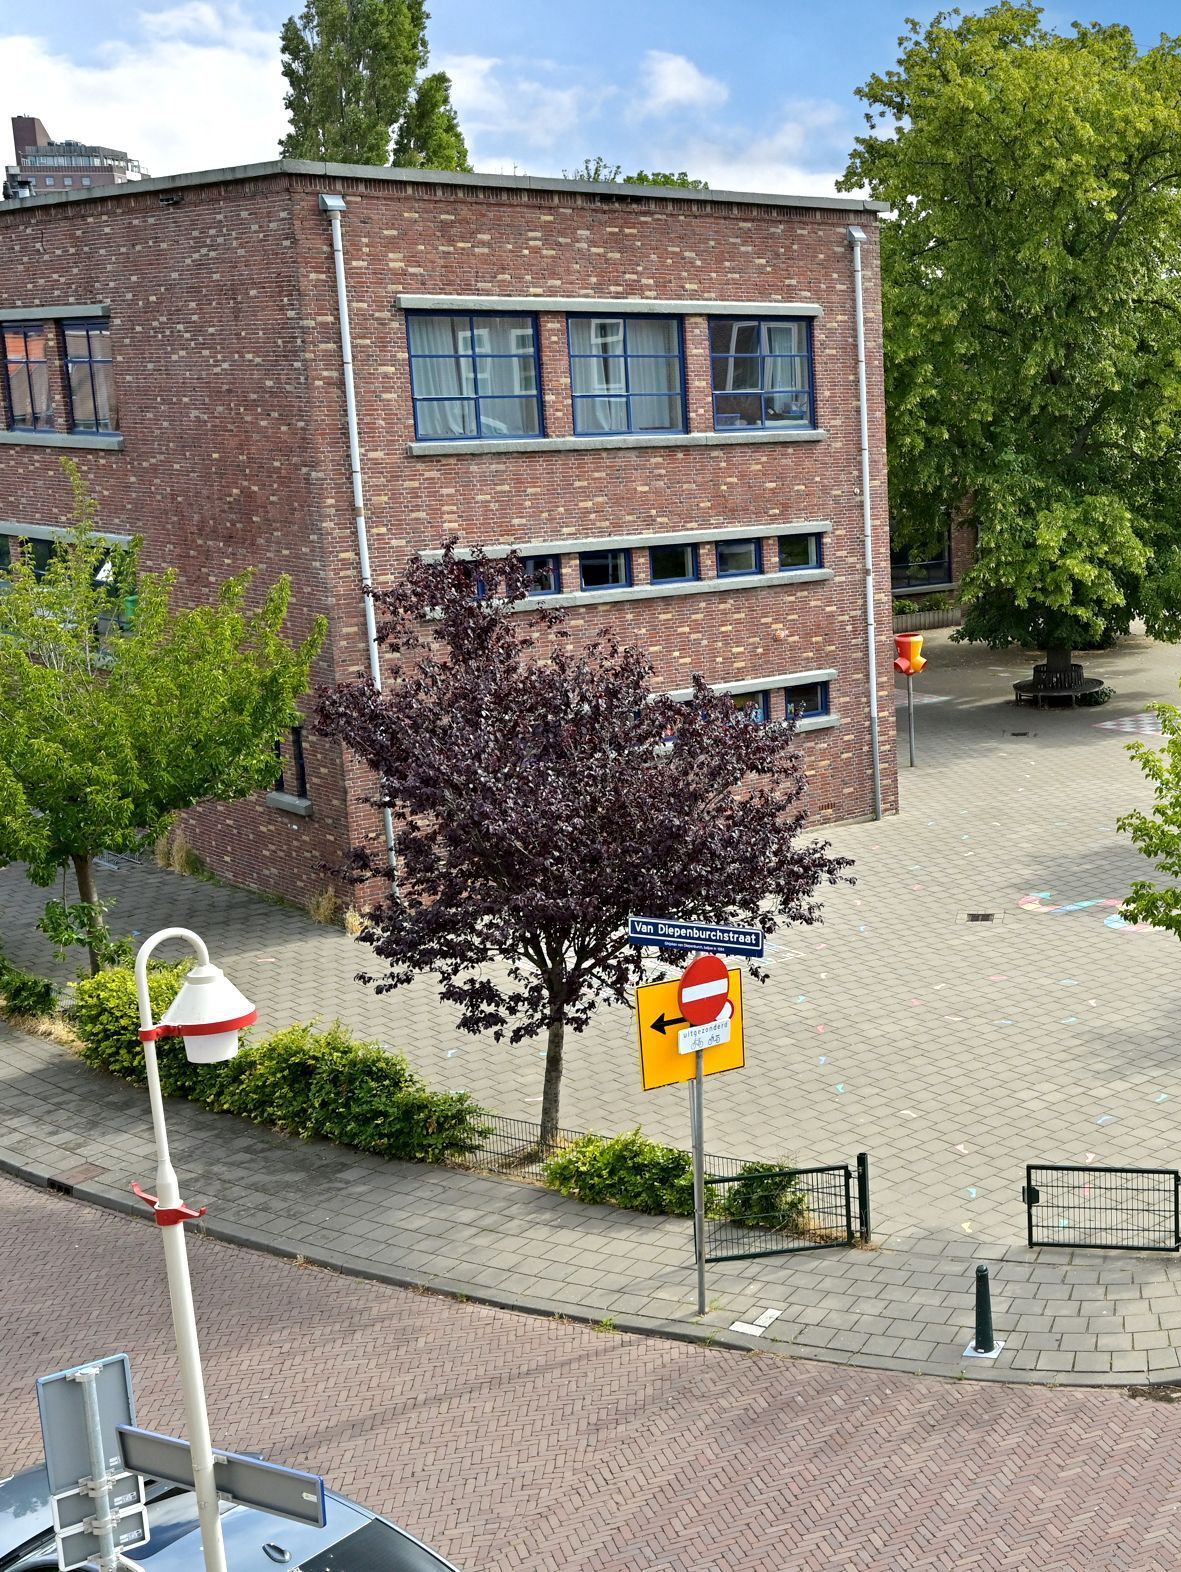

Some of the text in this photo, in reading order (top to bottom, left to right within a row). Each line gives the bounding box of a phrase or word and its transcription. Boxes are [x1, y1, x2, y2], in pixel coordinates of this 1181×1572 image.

[634, 922, 756, 944] Van Diepenburchstraat
[683, 1020, 728, 1039] uitgezonderd
